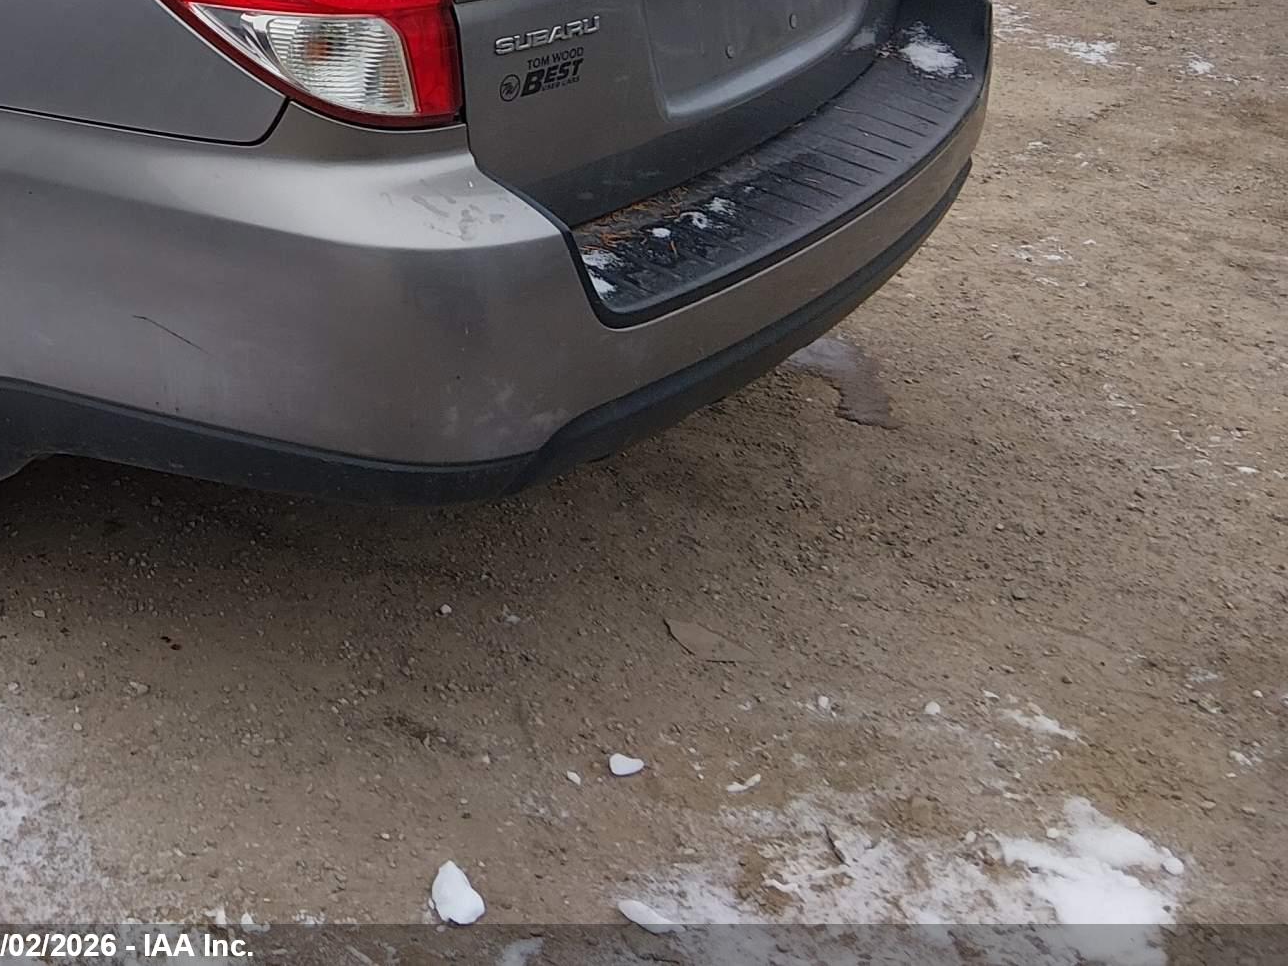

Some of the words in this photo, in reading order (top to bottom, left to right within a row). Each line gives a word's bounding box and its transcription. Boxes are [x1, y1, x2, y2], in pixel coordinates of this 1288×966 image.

[495, 15, 600, 55] SUBARU
[520, 58, 584, 97] BEST
[527, 55, 550, 69] TOM
[552, 47, 584, 64] WOOD
